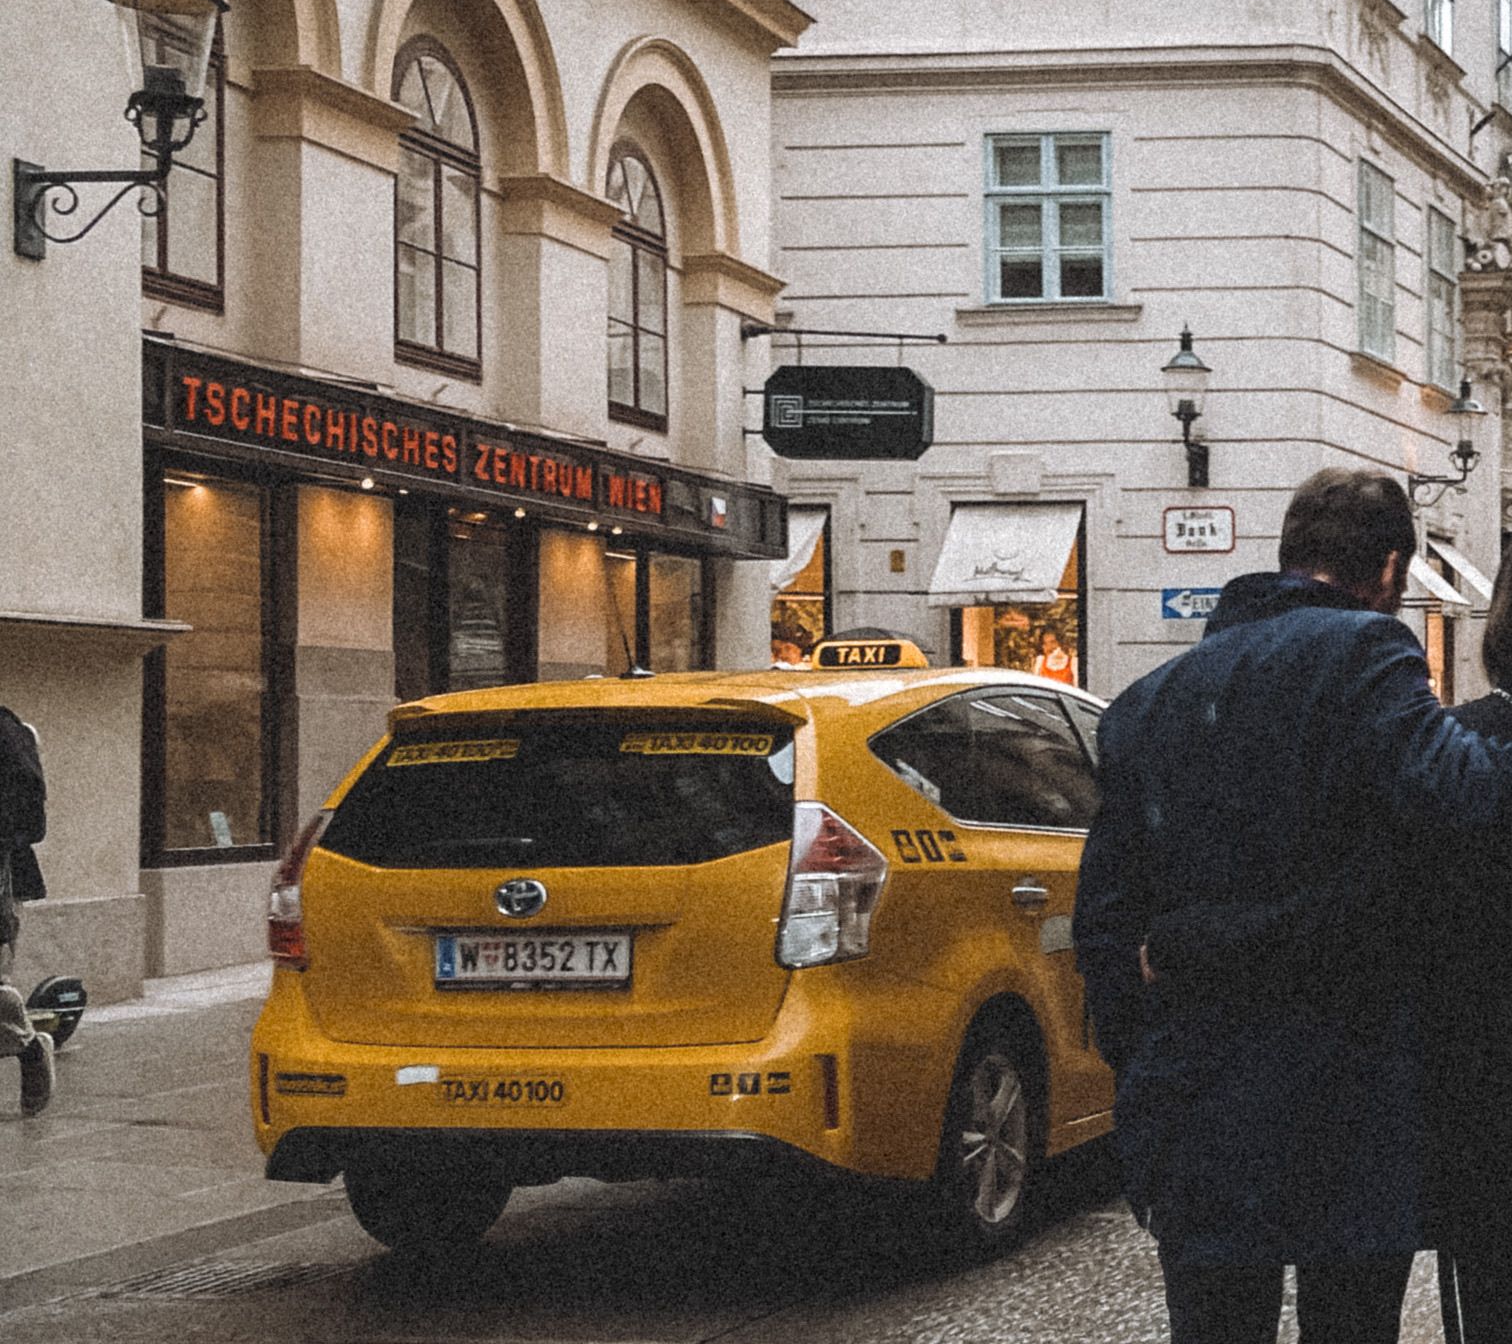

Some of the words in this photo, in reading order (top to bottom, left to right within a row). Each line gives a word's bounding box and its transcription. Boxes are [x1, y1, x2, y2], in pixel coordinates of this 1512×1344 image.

[182, 376, 458, 474] TSCHECHISCHES
[474, 442, 593, 501] ZENTRUM
[608, 474, 663, 515] WIEN
[836, 646, 886, 664] TAXI
[460, 942, 480, 972] W
[503, 941, 576, 972] 8352
[585, 941, 620, 972] TX
[441, 1079, 490, 1102] TAXI
[494, 1079, 566, 1102] 40100
